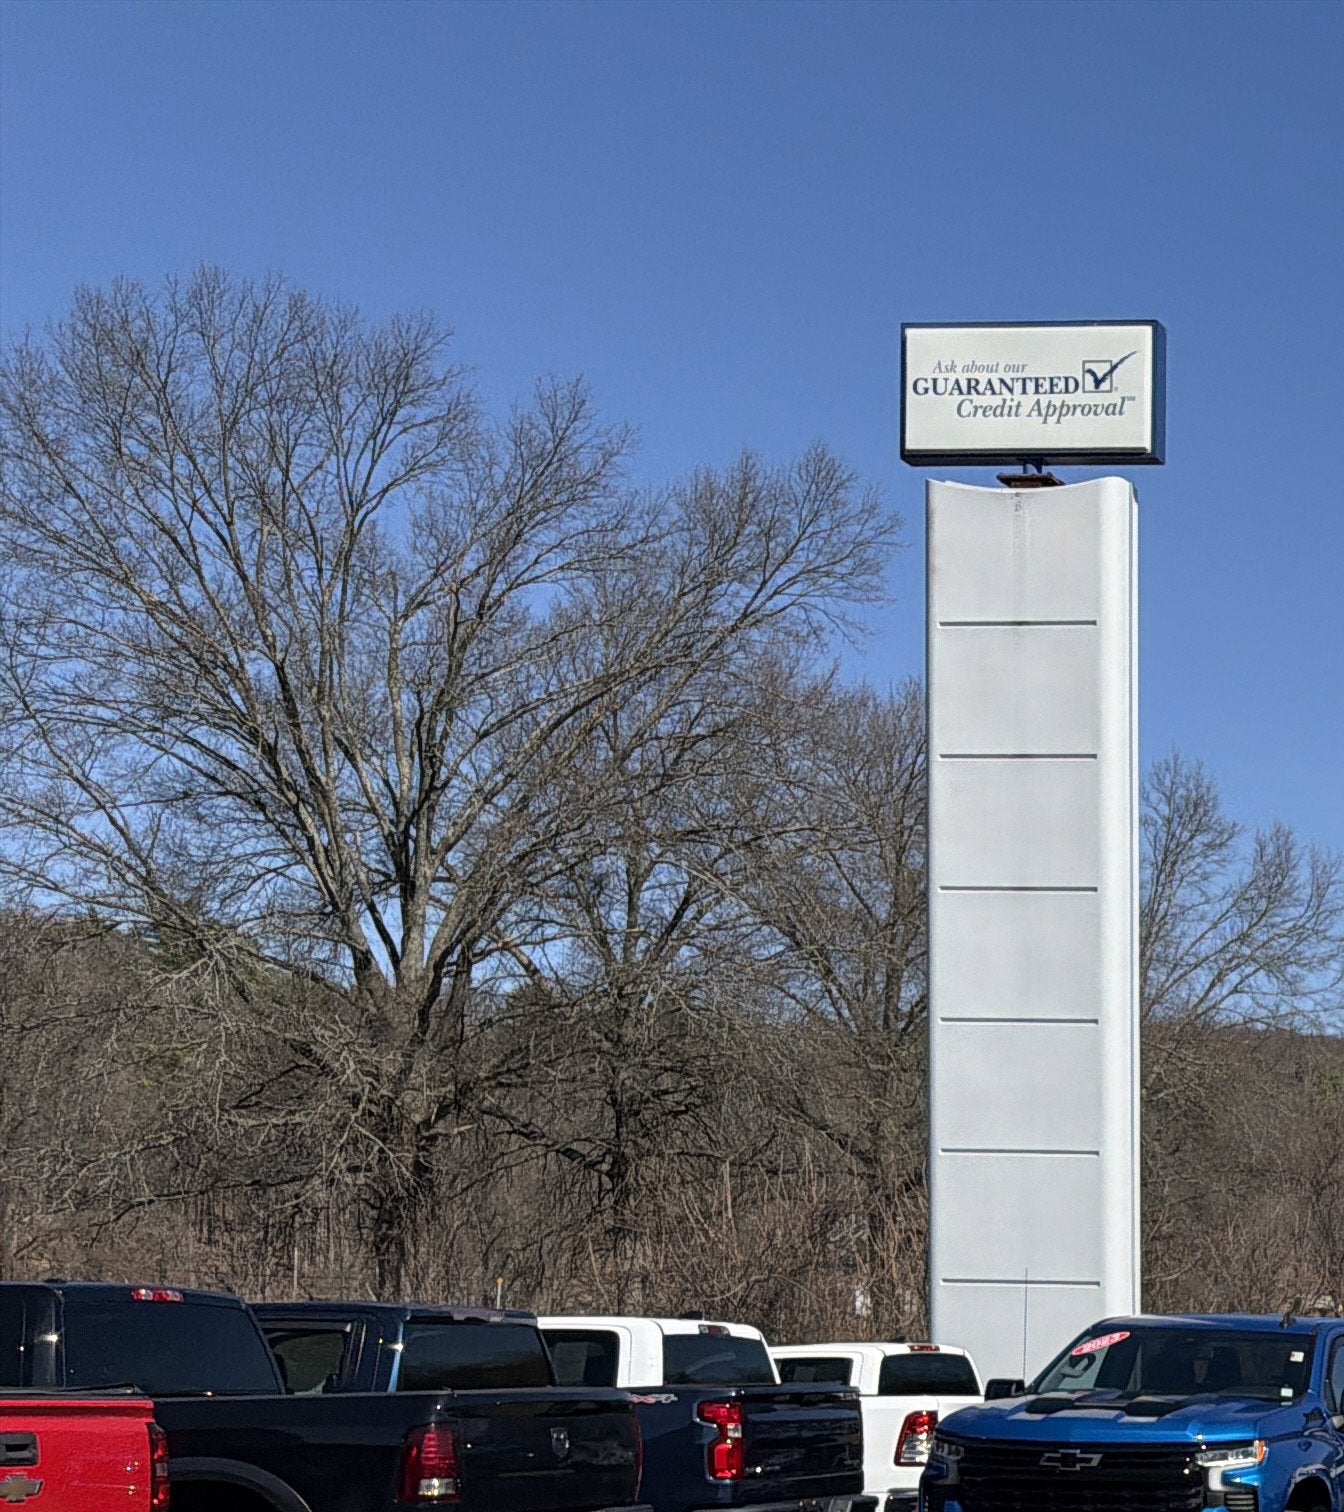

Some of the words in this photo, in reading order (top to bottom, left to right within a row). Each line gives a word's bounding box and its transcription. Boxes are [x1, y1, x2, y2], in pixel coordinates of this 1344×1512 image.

[933, 360, 957, 374] Ask
[961, 360, 1000, 374] about
[1004, 363, 1028, 374] our
[912, 376, 1080, 396] GUARANTEED
[956, 398, 1022, 418] Credit
[1026, 396, 1126, 424] Approval
